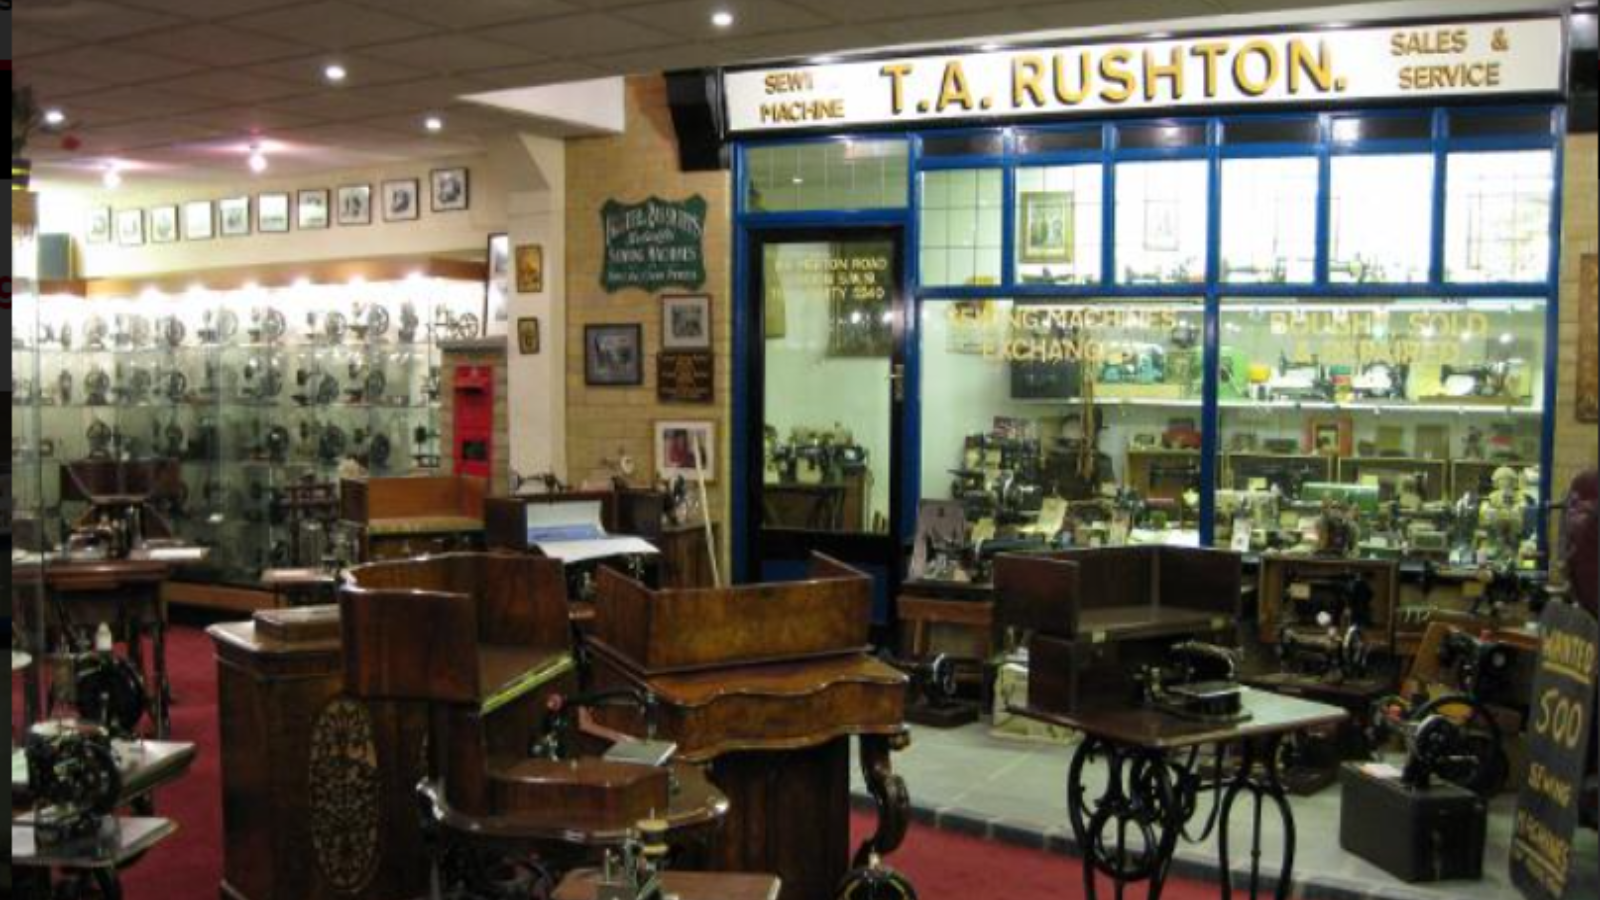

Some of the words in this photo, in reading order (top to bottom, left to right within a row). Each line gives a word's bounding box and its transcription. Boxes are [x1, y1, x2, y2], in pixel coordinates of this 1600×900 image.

[1390, 29, 1468, 56] SALES
[1490, 28, 1509, 52] &
[880, 60, 993, 115] T.A.
[1011, 38, 1347, 108] RUSHTON.
[1398, 62, 1500, 90] SERVICE
[760, 98, 845, 124] MACHINE
[1409, 312, 1488, 337] SOLD
[982, 338, 1133, 363] EXCHANGD
